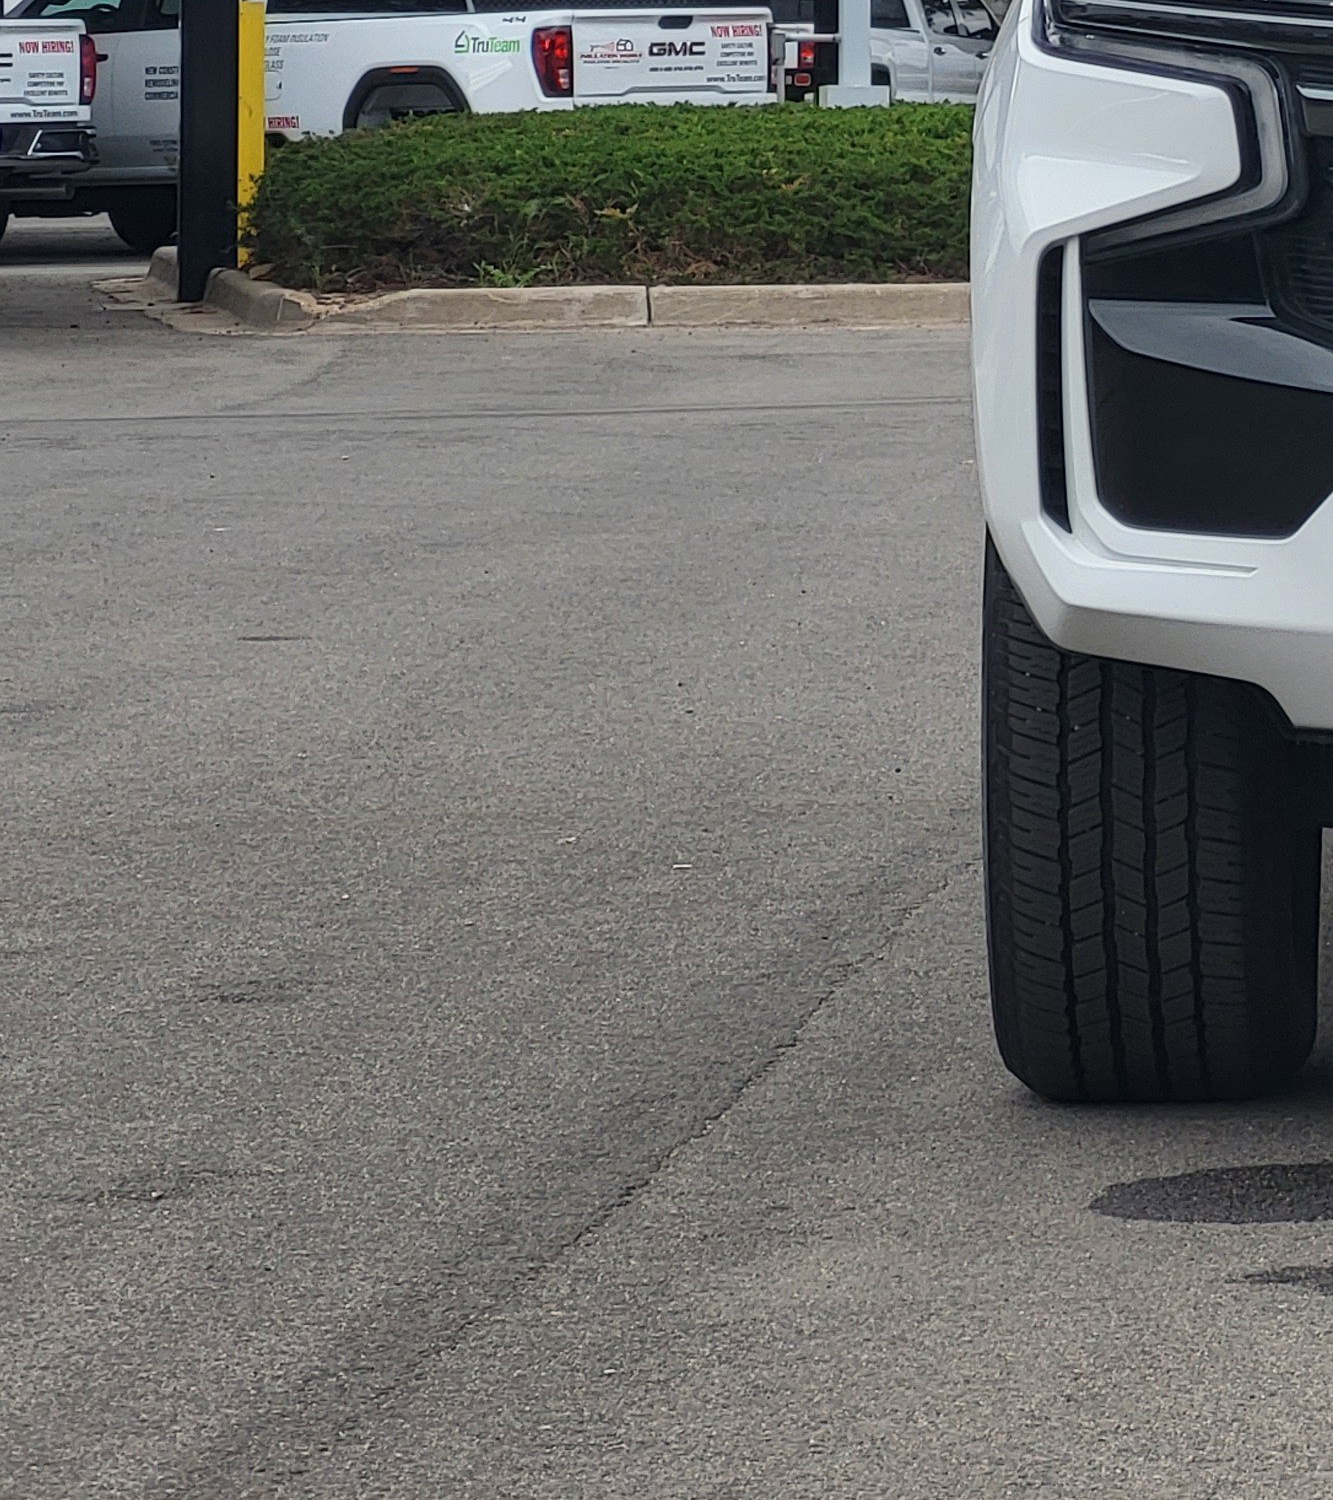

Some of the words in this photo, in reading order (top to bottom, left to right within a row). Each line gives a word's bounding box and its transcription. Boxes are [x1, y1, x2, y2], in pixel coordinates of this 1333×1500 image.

[710, 25, 730, 38] NOW
[732, 24, 763, 38] HIRING!
[18, 41, 39, 54] NOW
[41, 40, 75, 54] HIRING!
[471, 37, 520, 53] TruTeam
[648, 41, 706, 57] GMC
[10, 109, 79, 118] www.TruTeam.com
[267, 116, 300, 129] HIRING!
